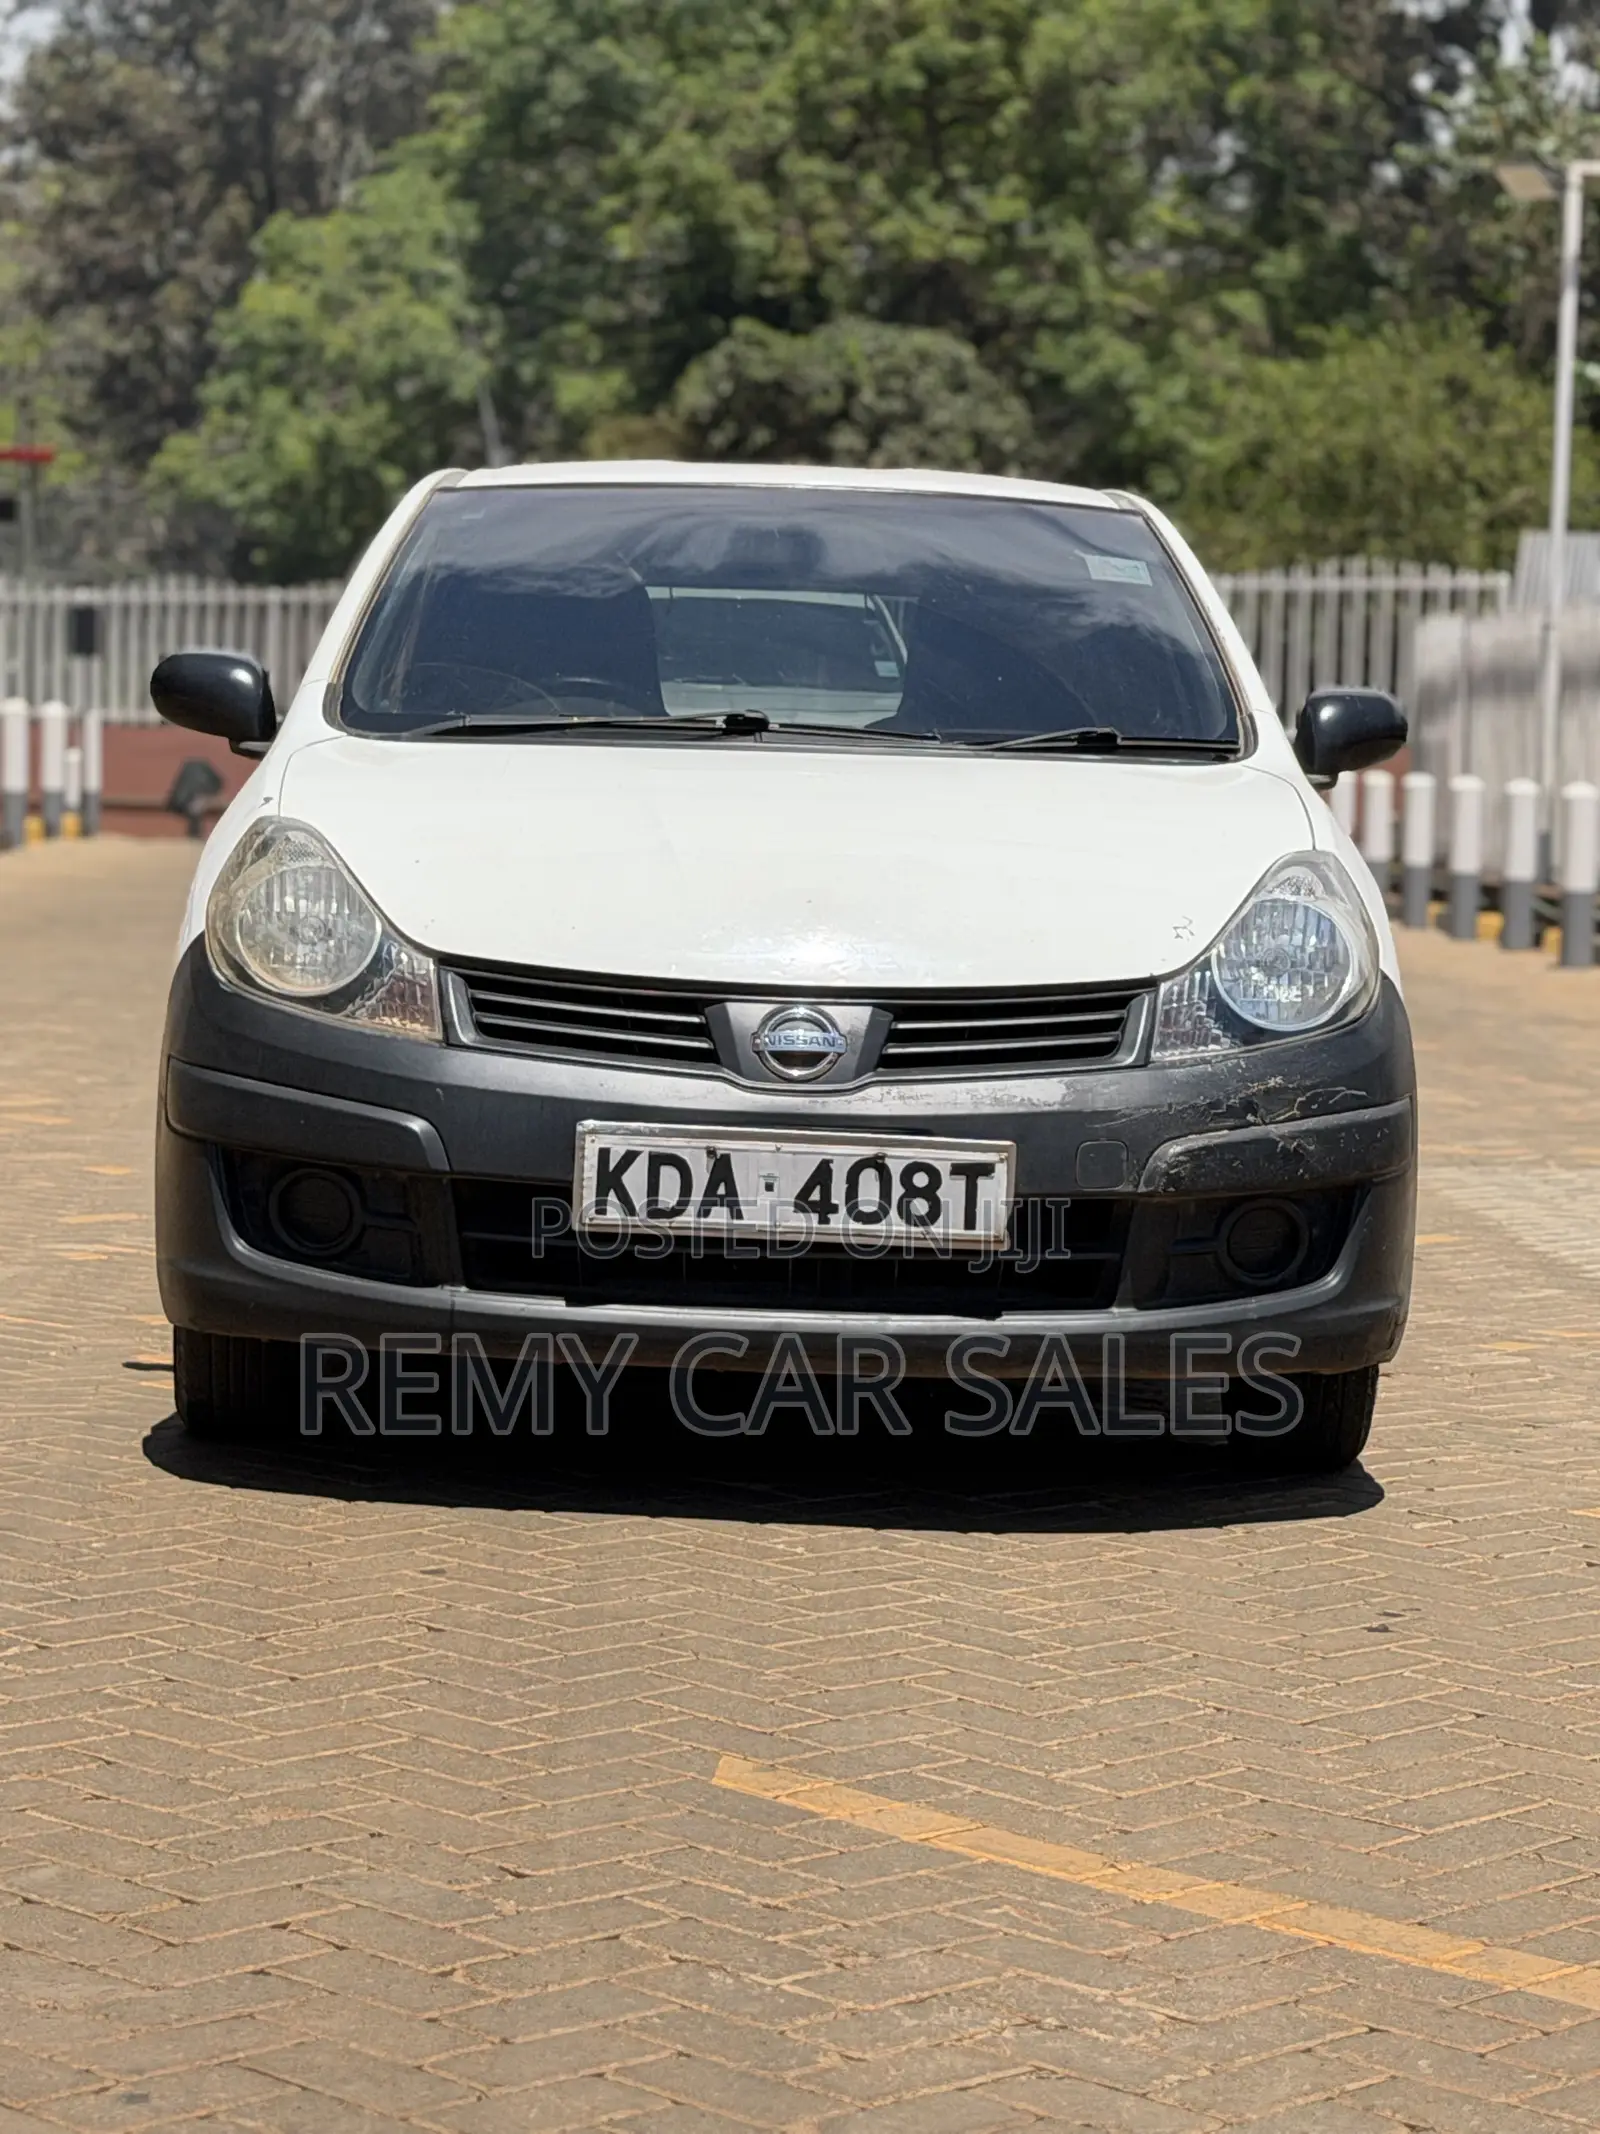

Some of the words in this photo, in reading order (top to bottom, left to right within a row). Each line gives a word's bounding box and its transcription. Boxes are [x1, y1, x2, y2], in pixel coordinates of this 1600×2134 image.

[765, 1034, 836, 1047] NISSAN
[595, 1147, 745, 1220] KDA
[793, 1157, 996, 1231] 408T
